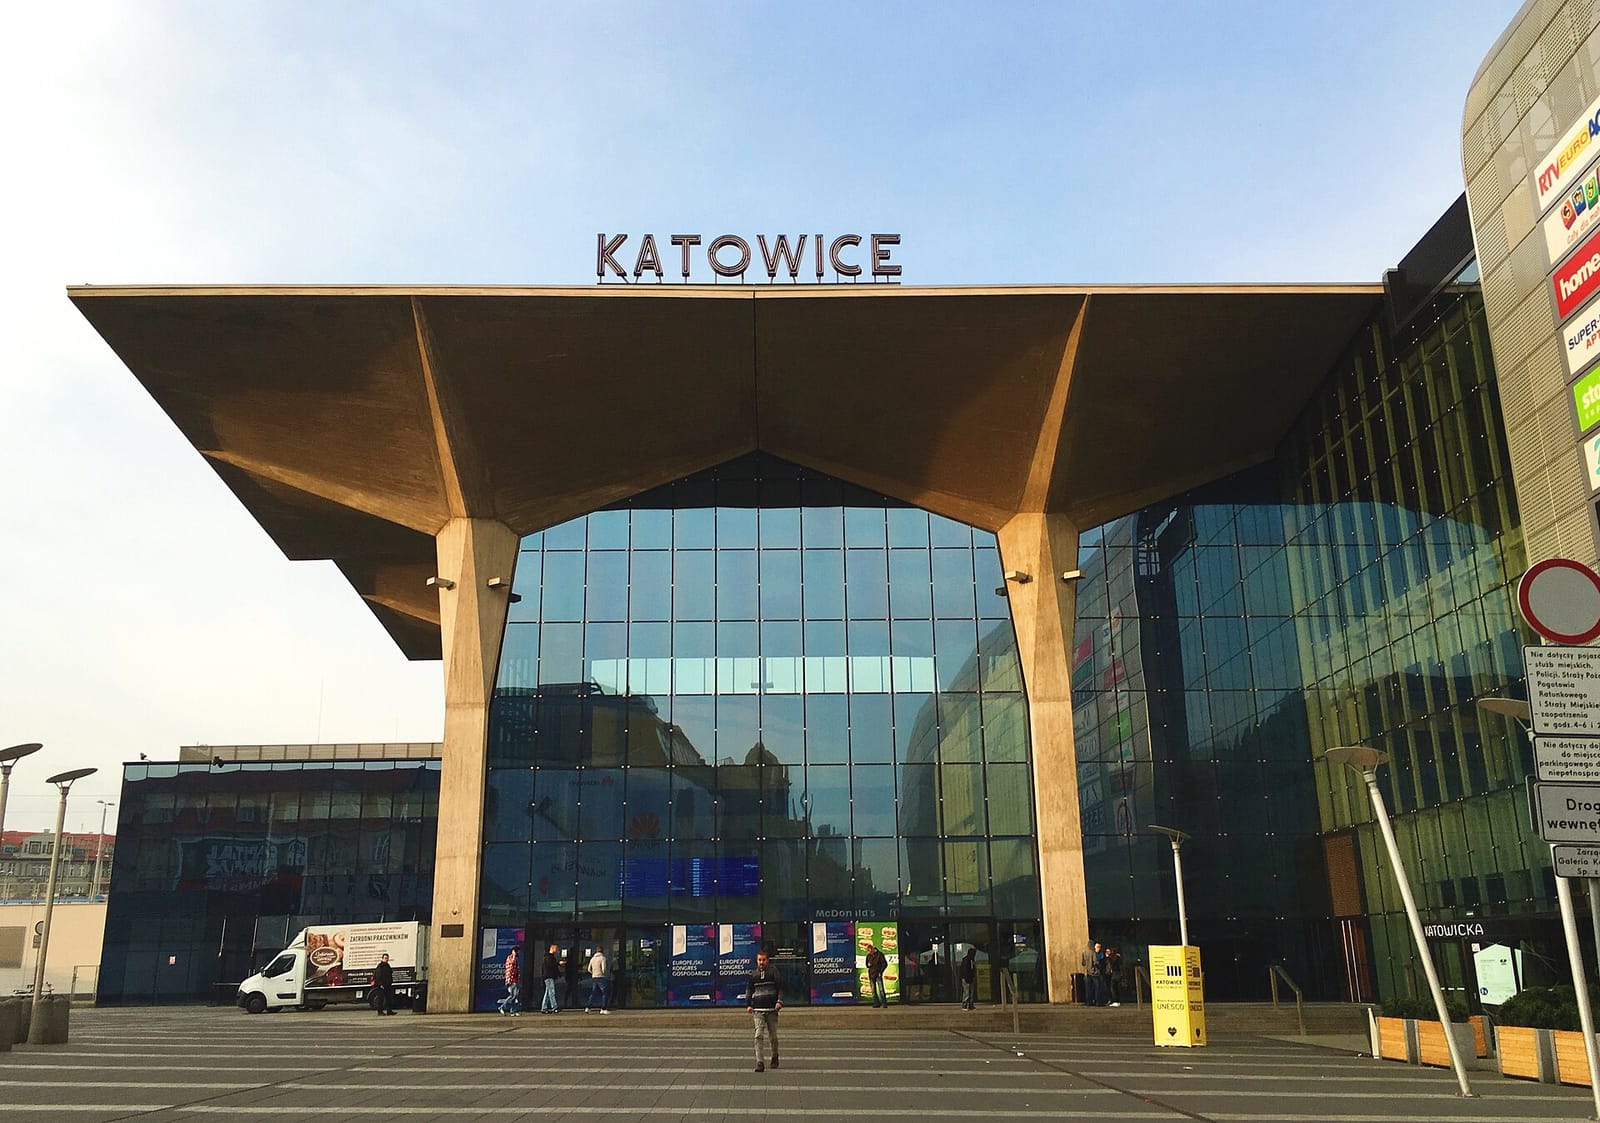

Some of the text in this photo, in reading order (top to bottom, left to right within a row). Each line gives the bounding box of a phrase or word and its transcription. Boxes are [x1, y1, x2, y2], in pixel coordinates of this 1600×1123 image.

[1538, 160, 1561, 197] RTV
[1559, 131, 1588, 168] EURO
[597, 233, 902, 277] KATOWICE
[1568, 315, 1600, 350] SUPER-
[1547, 651, 1573, 659] dotyczy
[1562, 671, 1584, 679] Straży
[1537, 681, 1575, 689] Pogotowia
[1539, 691, 1588, 699] Ratunkowego
[1544, 700, 1566, 709] Straży
[1570, 701, 1600, 709] Miejskie
[1541, 711, 1588, 719] zaopatrzenia
[1543, 741, 1556, 749] Nie
[1559, 741, 1587, 750] dotyczy
[1540, 760, 1594, 769] parkingowego
[1566, 798, 1600, 815] Drog
[1577, 849, 1600, 858] Zarzą
[1558, 857, 1589, 865] Galeria
[1577, 868, 1590, 876] Sp.
[815, 909, 876, 917] McDonld's
[1424, 923, 1484, 937] KATOWICKA
